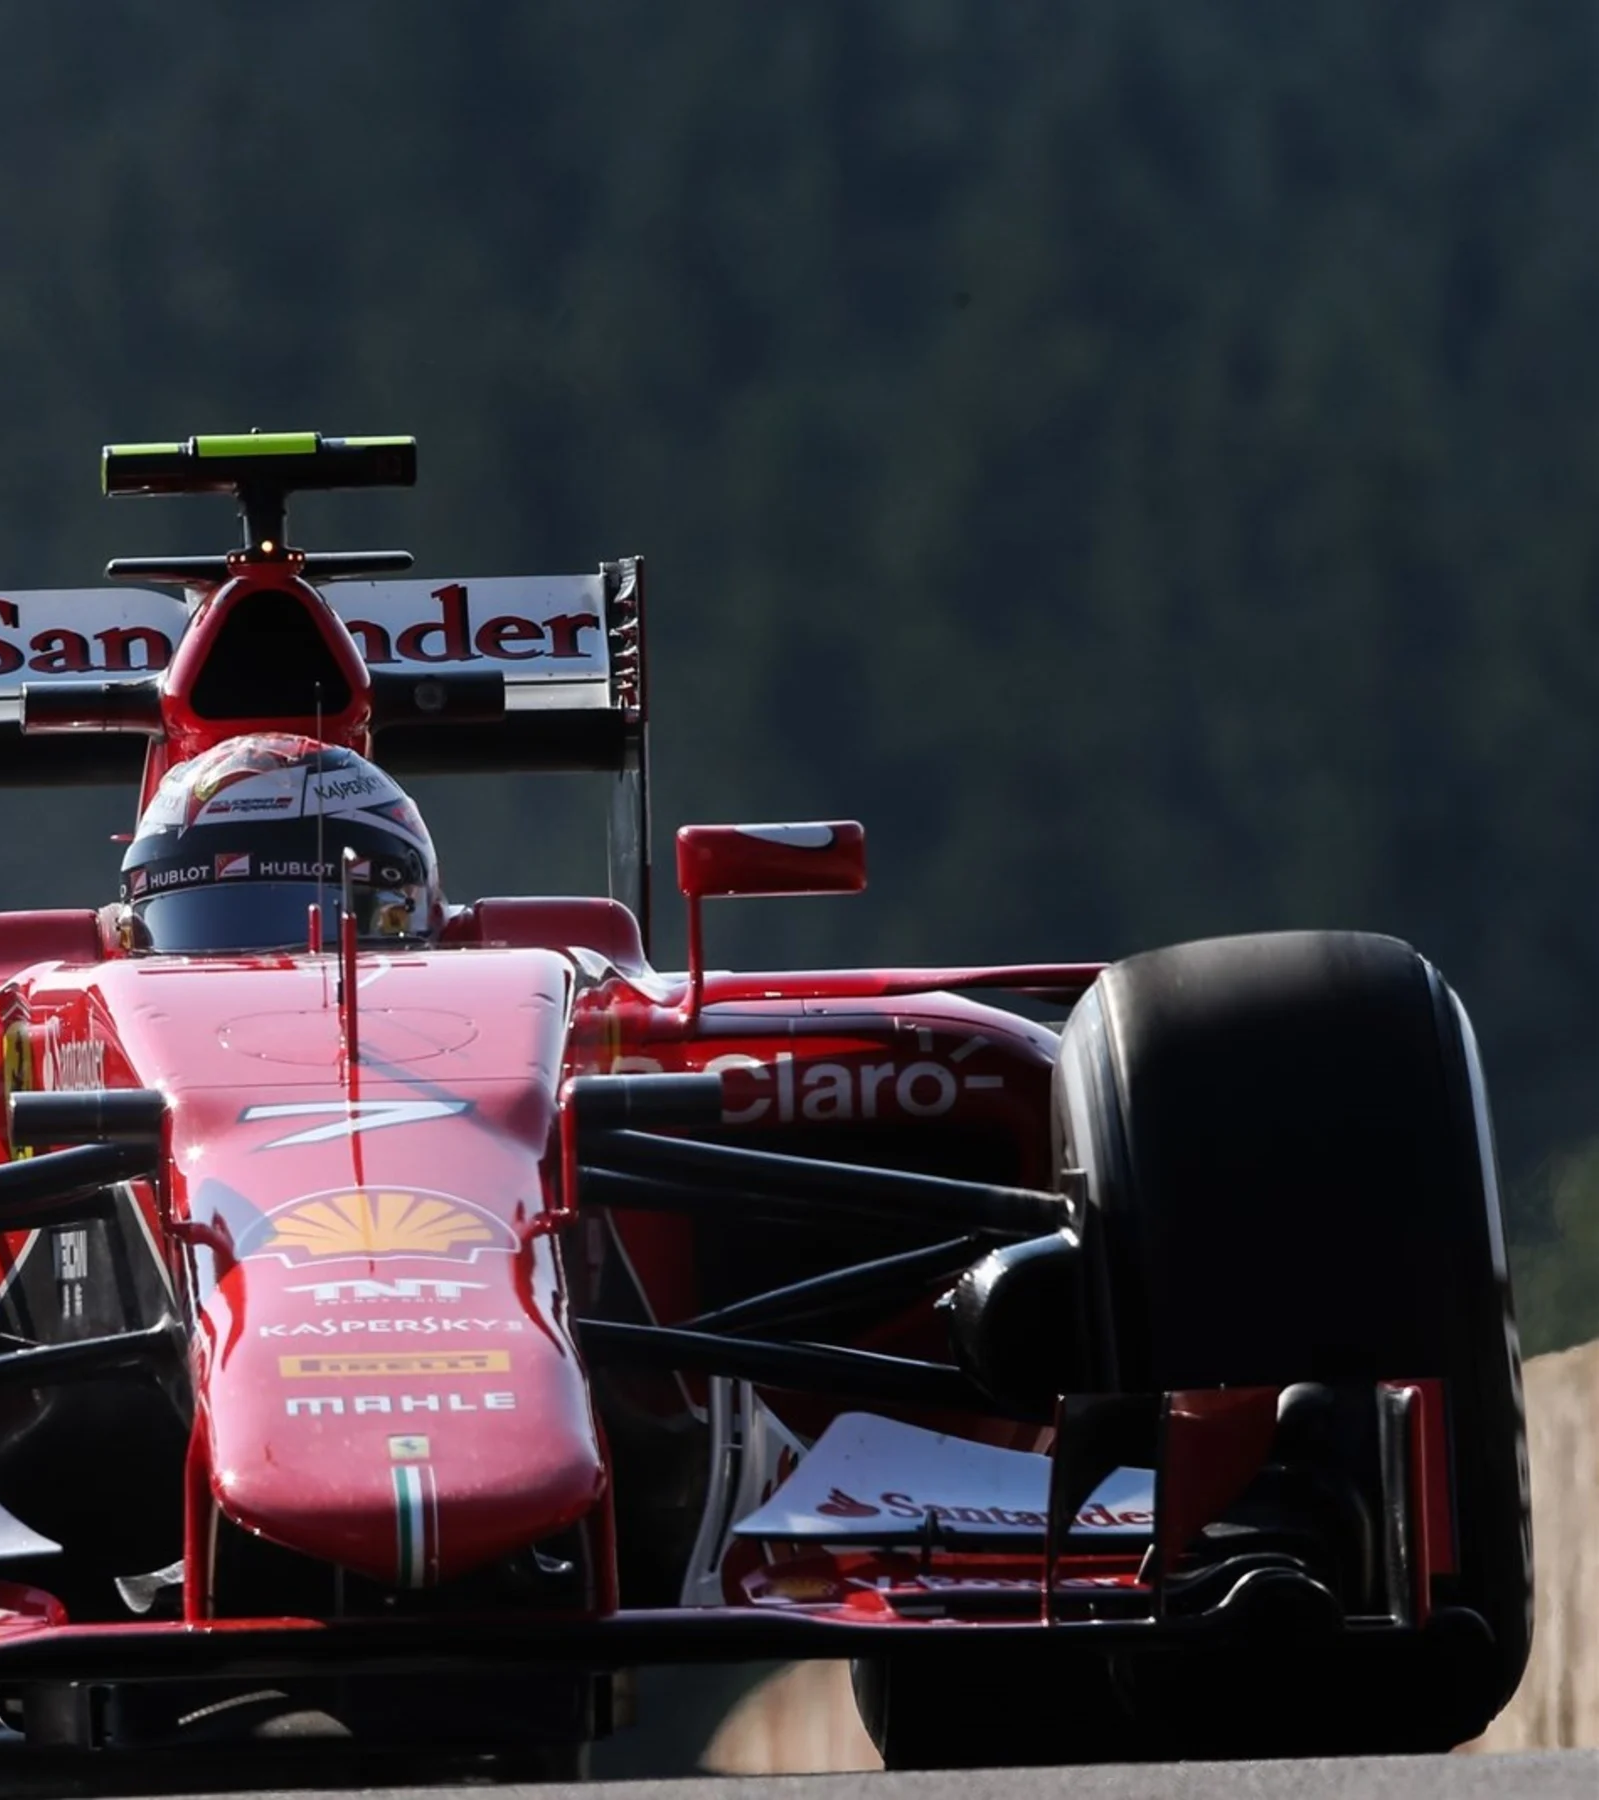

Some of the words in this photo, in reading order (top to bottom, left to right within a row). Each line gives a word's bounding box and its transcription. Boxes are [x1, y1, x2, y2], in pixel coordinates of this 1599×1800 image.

[150, 865, 210, 887] HUBLOT
[260, 861, 336, 877] HUBLOT
[703, 1051, 955, 1123] Claro
[238, 1099, 475, 1154] 7
[283, 1279, 492, 1299] TNT
[260, 1317, 499, 1337] KASPERSKY
[286, 1392, 516, 1415] MAHLE
[880, 1491, 1154, 1529] Santade
